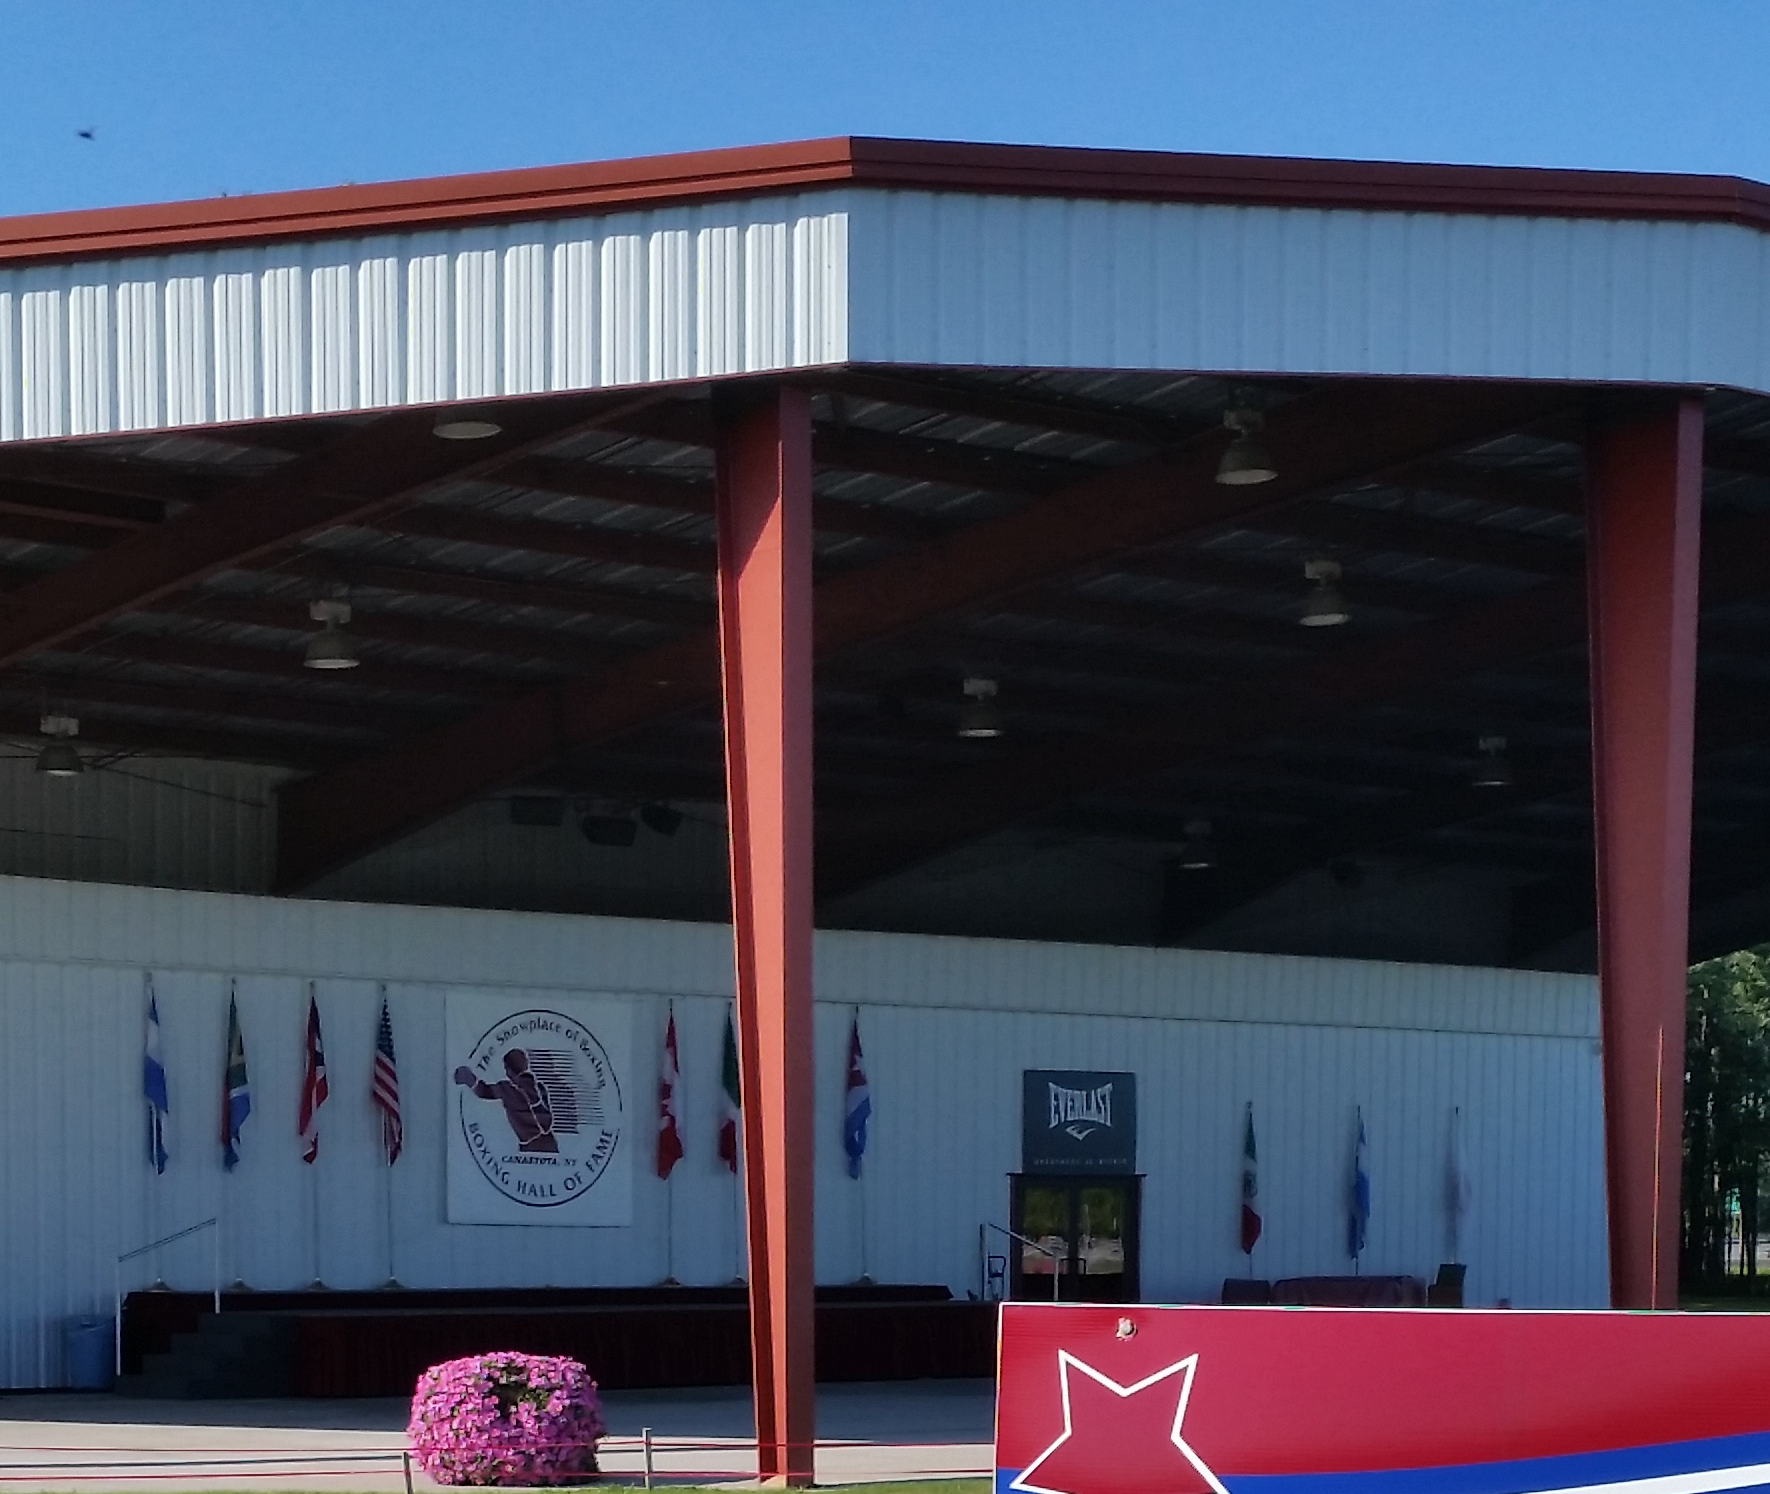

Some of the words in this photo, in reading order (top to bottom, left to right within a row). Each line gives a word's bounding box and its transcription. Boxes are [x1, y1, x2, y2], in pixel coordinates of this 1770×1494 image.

[1048, 1082, 1113, 1128] EVERLAST
[468, 1122, 510, 1186] BOXING
[517, 1180, 557, 1197] HALL
[564, 1171, 584, 1190] OF
[585, 1130, 613, 1172] FAME
